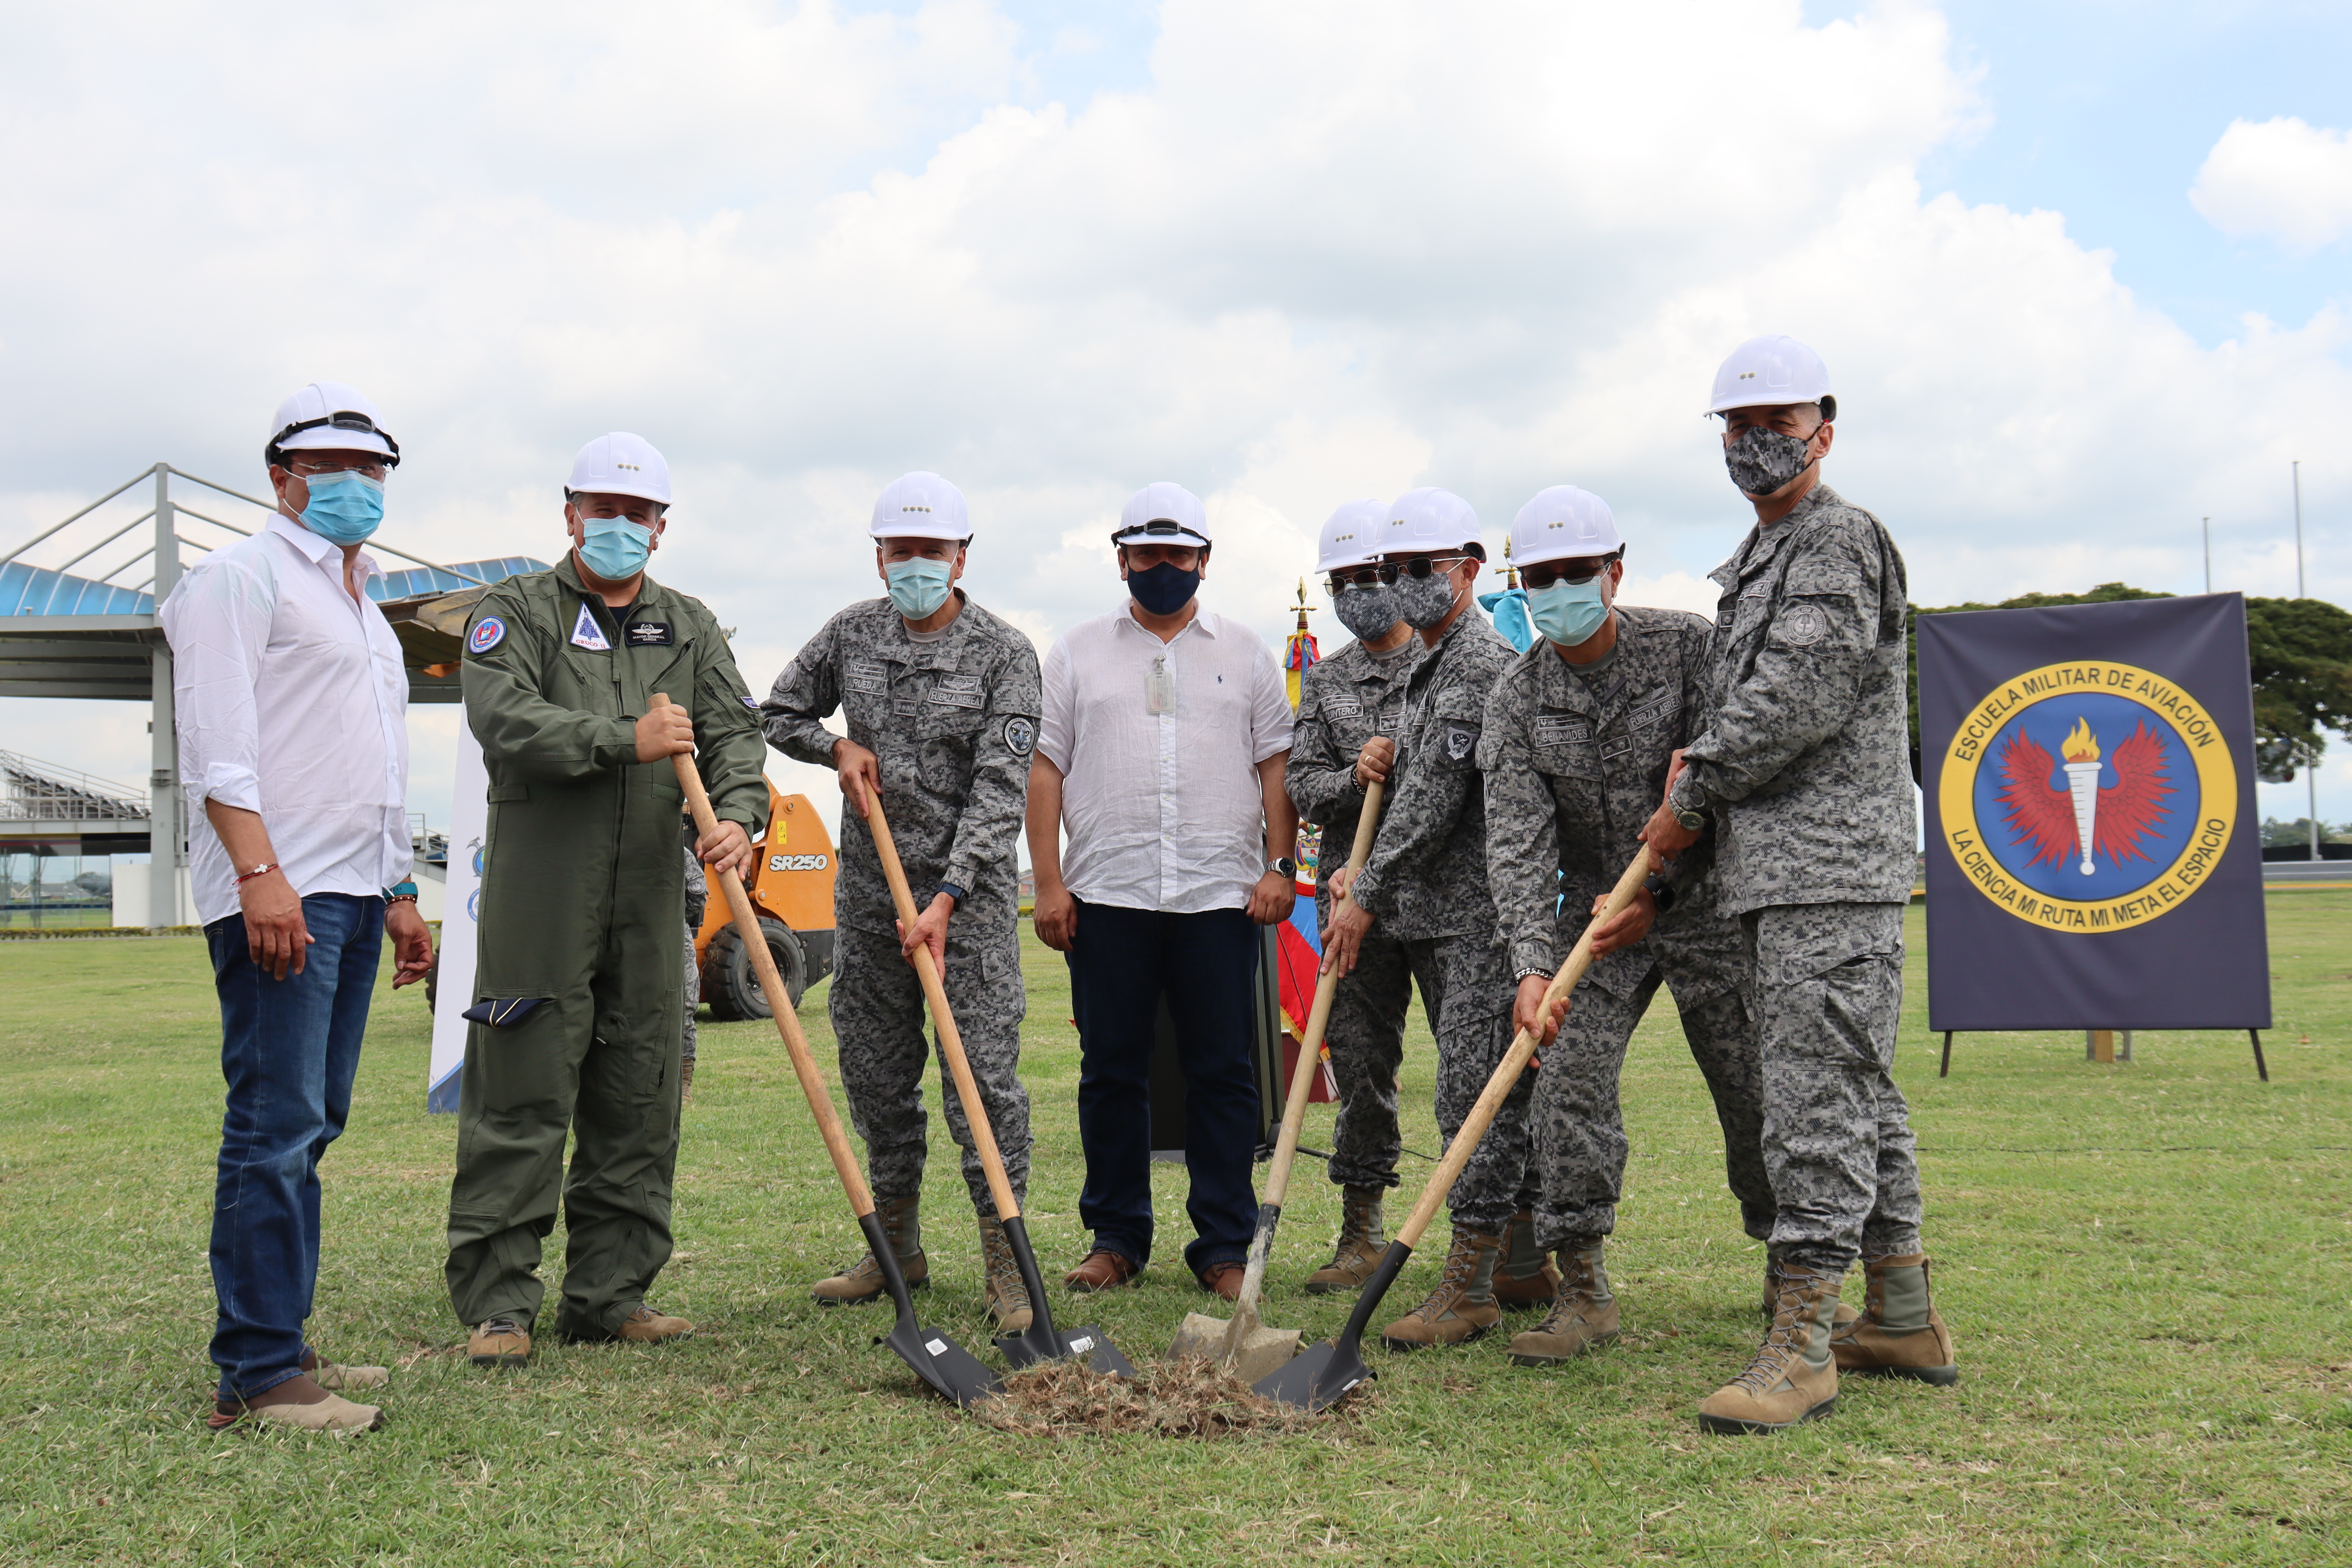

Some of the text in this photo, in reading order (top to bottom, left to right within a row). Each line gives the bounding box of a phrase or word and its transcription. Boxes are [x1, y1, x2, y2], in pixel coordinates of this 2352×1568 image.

[853, 679, 876, 691] RUEDA
[930, 691, 979, 706] FUERZA AEREA
[1325, 706, 1356, 720] QUINTERO
[1630, 696, 1682, 727] FUERZA AEREA
[1955, 667, 2216, 762] ESCUELA MILITAR DE AVIACIÓN
[1542, 729, 1588, 742] BENAVIDES
[769, 854, 828, 871] SR250
[1952, 818, 2226, 927] LA CIENCIA MI RUTA MI META EL ESPACIO
